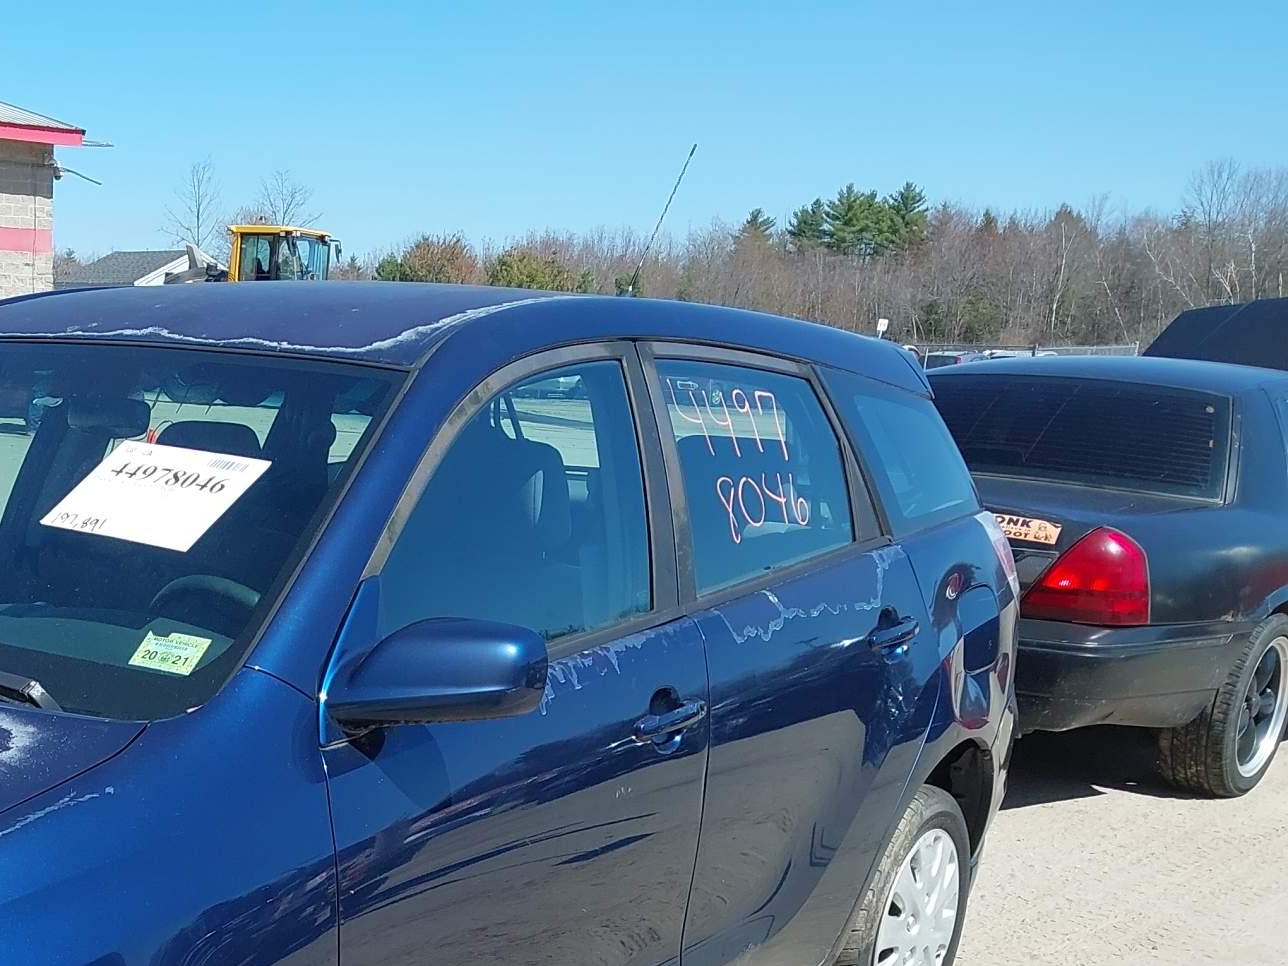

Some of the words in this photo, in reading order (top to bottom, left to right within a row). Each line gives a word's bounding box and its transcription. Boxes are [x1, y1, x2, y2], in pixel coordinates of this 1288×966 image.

[666, 378, 789, 461] 4497
[110, 462, 227, 494] 44978046
[716, 473, 809, 544] 8046
[141, 649, 158, 661] 20
[171, 654, 190, 666] 21
